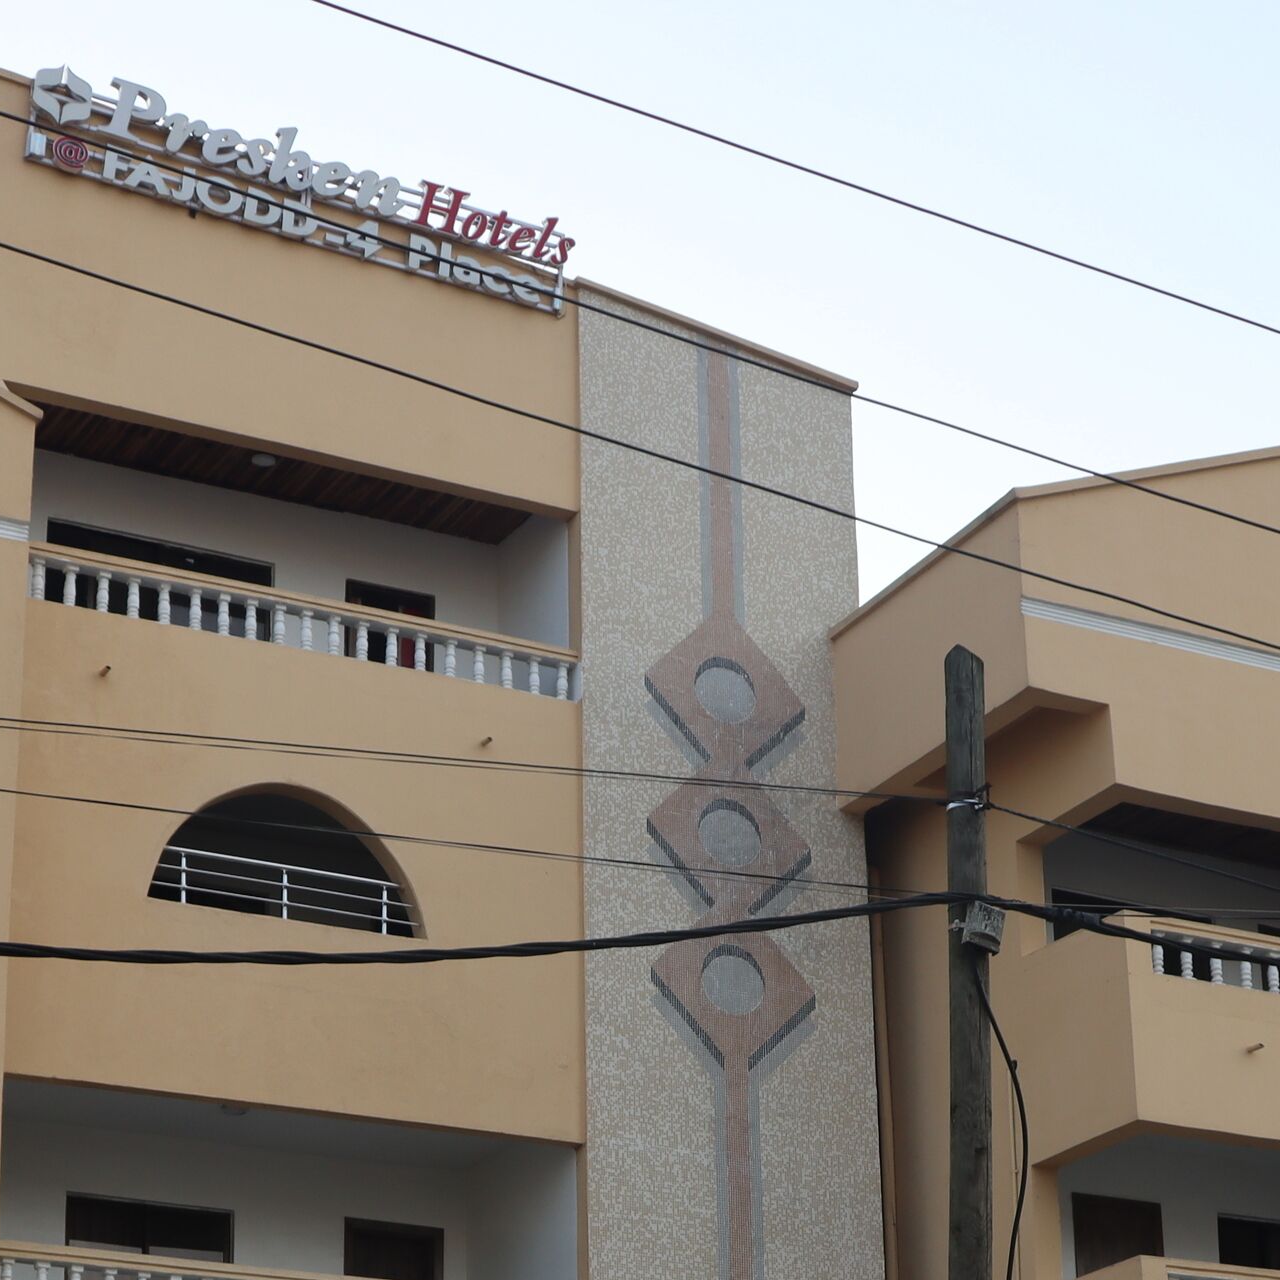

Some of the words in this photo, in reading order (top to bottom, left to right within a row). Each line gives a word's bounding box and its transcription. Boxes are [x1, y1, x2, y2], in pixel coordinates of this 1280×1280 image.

[52, 135, 89, 172] @
[408, 232, 542, 304] Place
[96, 76, 405, 217] Presken
[411, 179, 576, 265] Hotels
